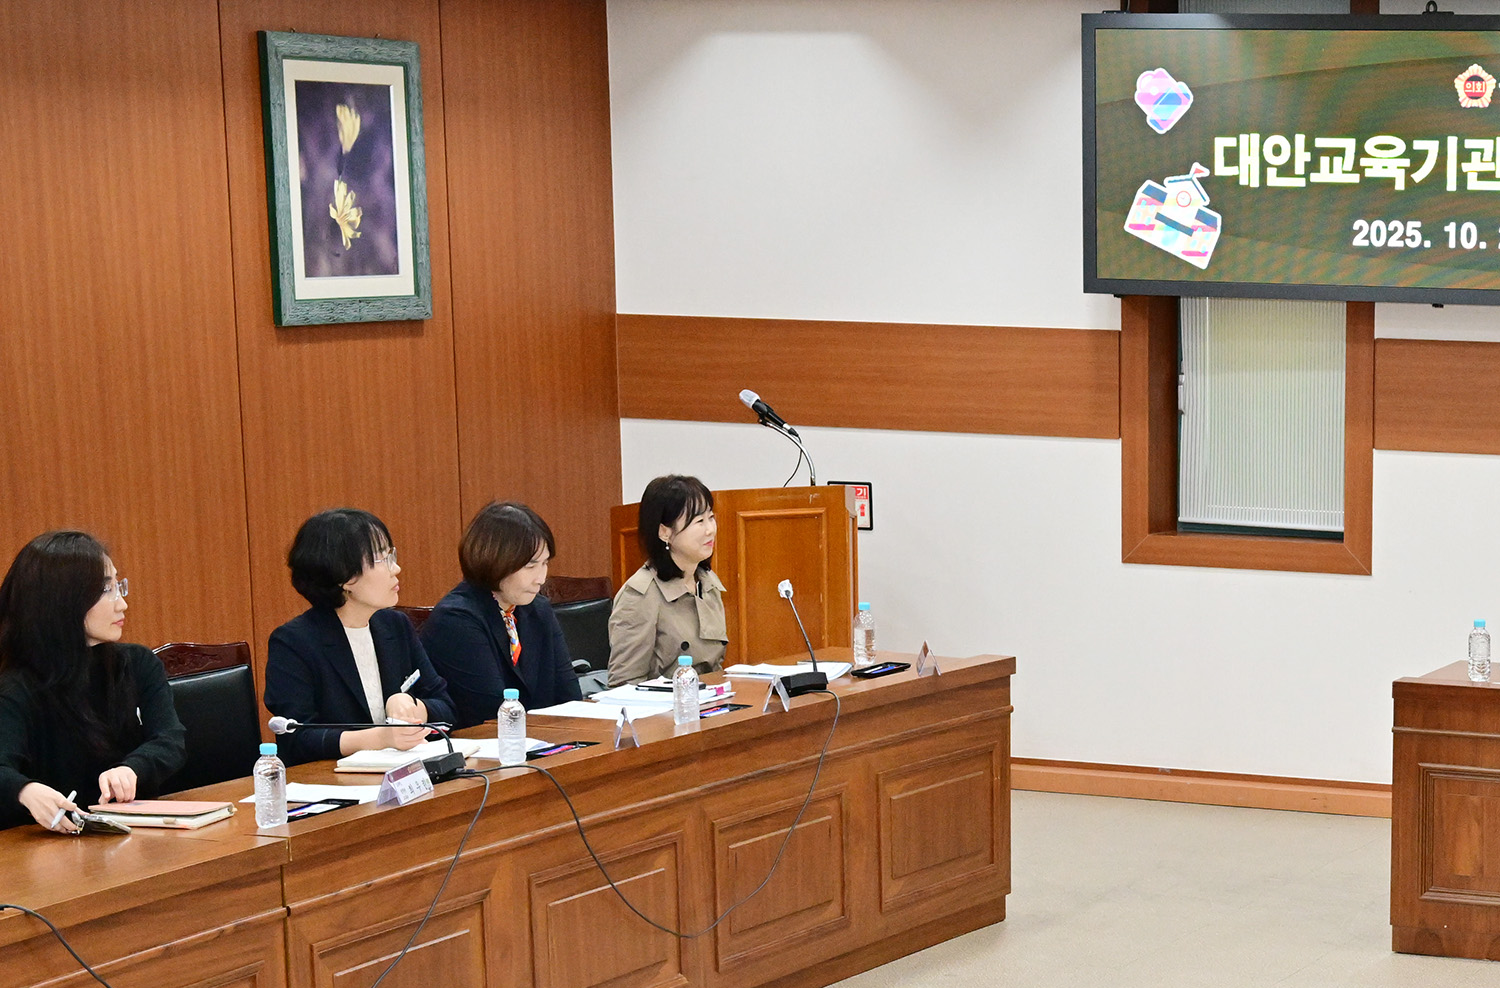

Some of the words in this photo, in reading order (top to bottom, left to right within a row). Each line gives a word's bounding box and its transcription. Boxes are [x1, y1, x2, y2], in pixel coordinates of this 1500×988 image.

[1464, 81, 1486, 93] 의회
[1353, 220, 1431, 249] 2025.
[1444, 222, 1487, 250] 10.
